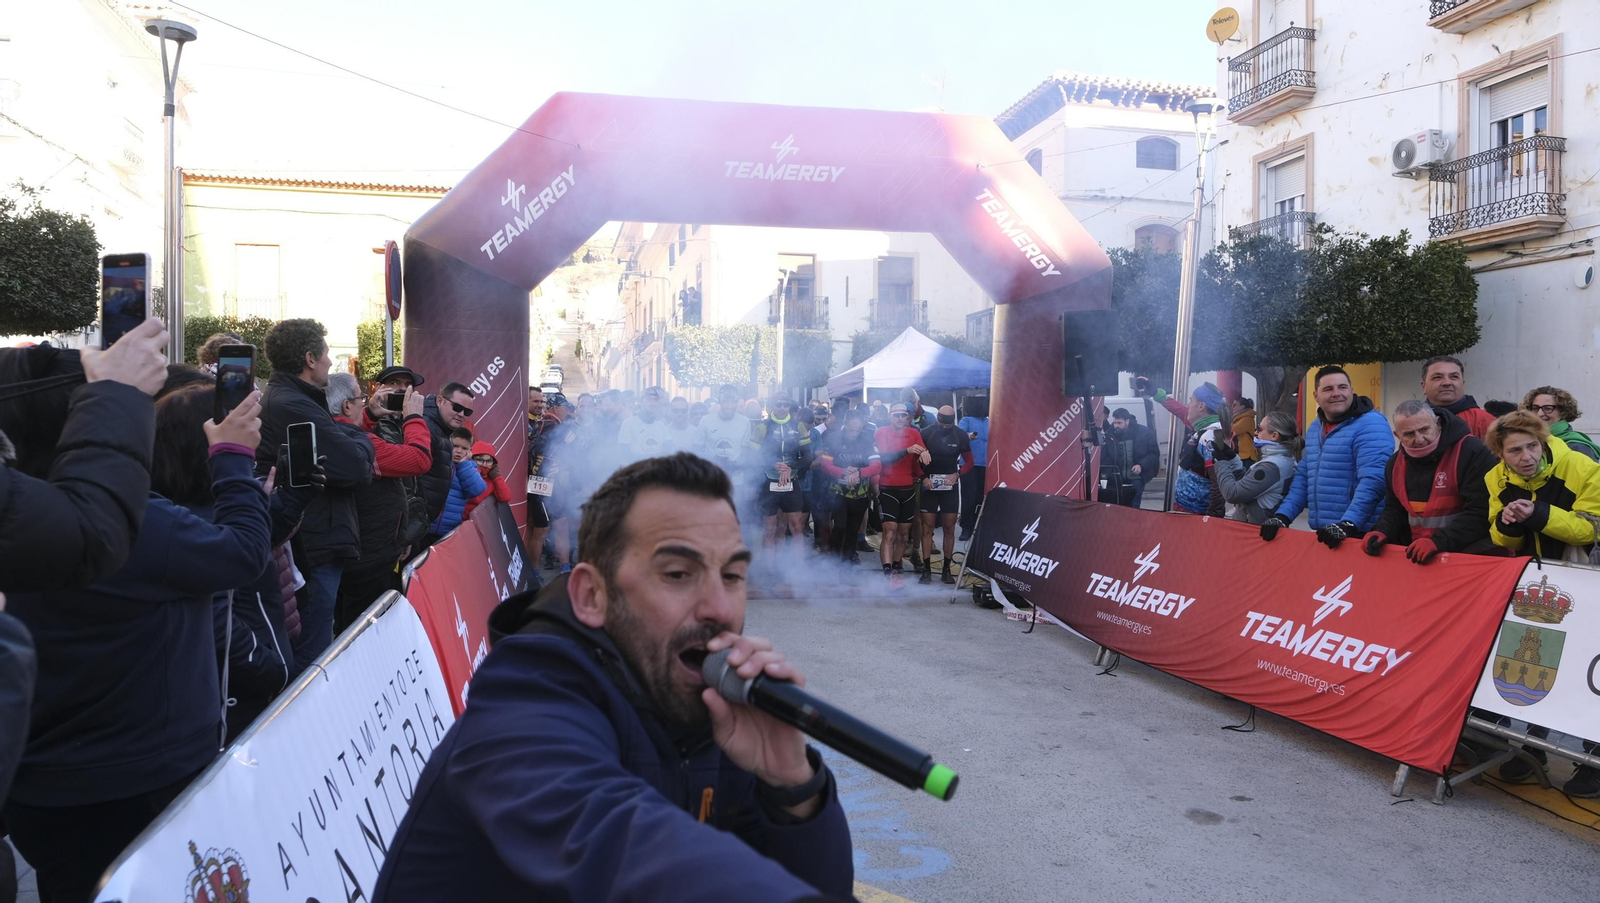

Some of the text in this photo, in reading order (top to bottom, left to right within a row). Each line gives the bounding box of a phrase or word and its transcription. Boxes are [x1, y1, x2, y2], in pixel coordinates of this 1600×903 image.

[724, 160, 846, 183] TEAMERGY
[480, 164, 576, 261] TEAMERGY
[974, 188, 1062, 278] TEAMERGY
[467, 355, 506, 399] gy.es
[1011, 396, 1085, 473] www.teamer
[533, 482, 548, 491] 119
[988, 541, 1060, 579] TEAMERGY
[1085, 572, 1196, 619] TEAMERGY
[1096, 609, 1152, 635] www.teamergy.es
[1239, 611, 1412, 676] TEAMERGY
[1256, 658, 1346, 696] www.teamergy.es
[277, 649, 423, 891] AYUNTAMIENTO DE
[305, 687, 445, 903] ANTORIA
